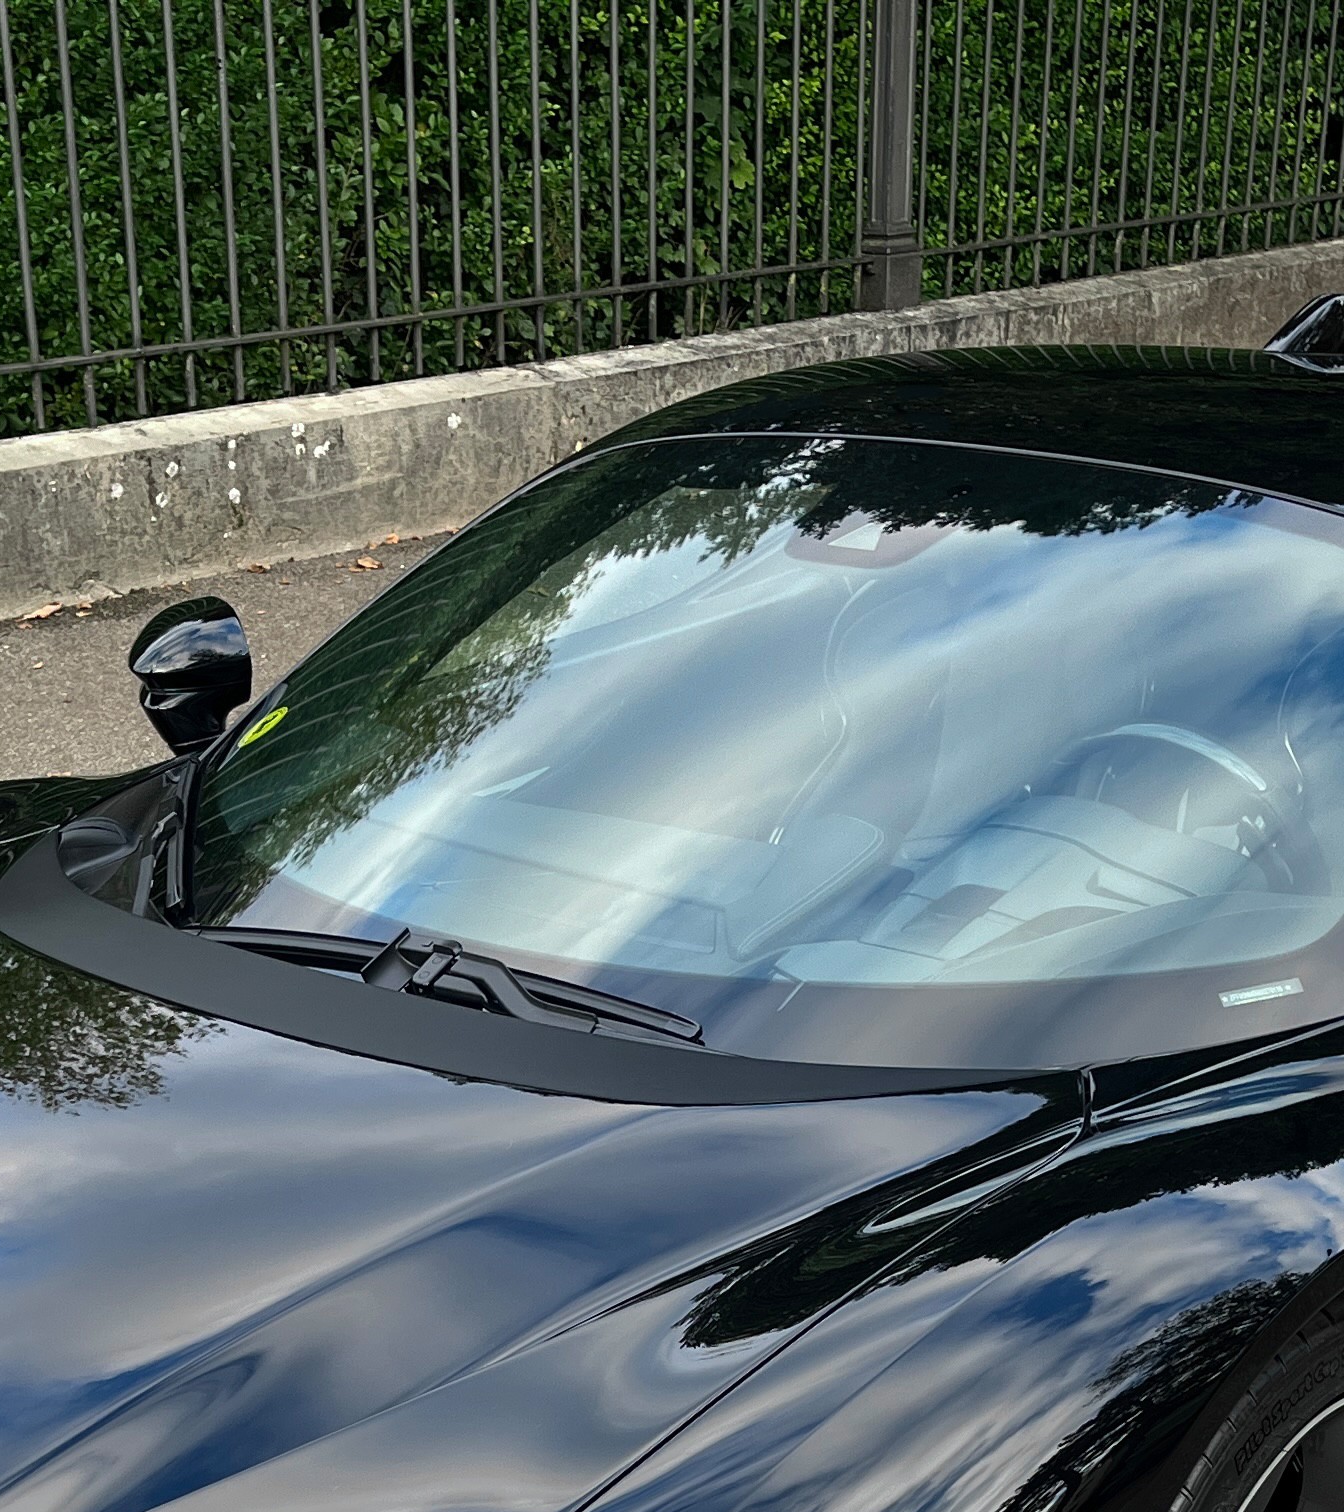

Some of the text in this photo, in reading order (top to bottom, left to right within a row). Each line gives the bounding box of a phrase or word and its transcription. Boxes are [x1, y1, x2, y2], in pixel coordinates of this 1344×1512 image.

[1233, 1415, 1273, 1477] Pilot
[1271, 1370, 1314, 1429] Sport
[1314, 1355, 1340, 1385] Cup
